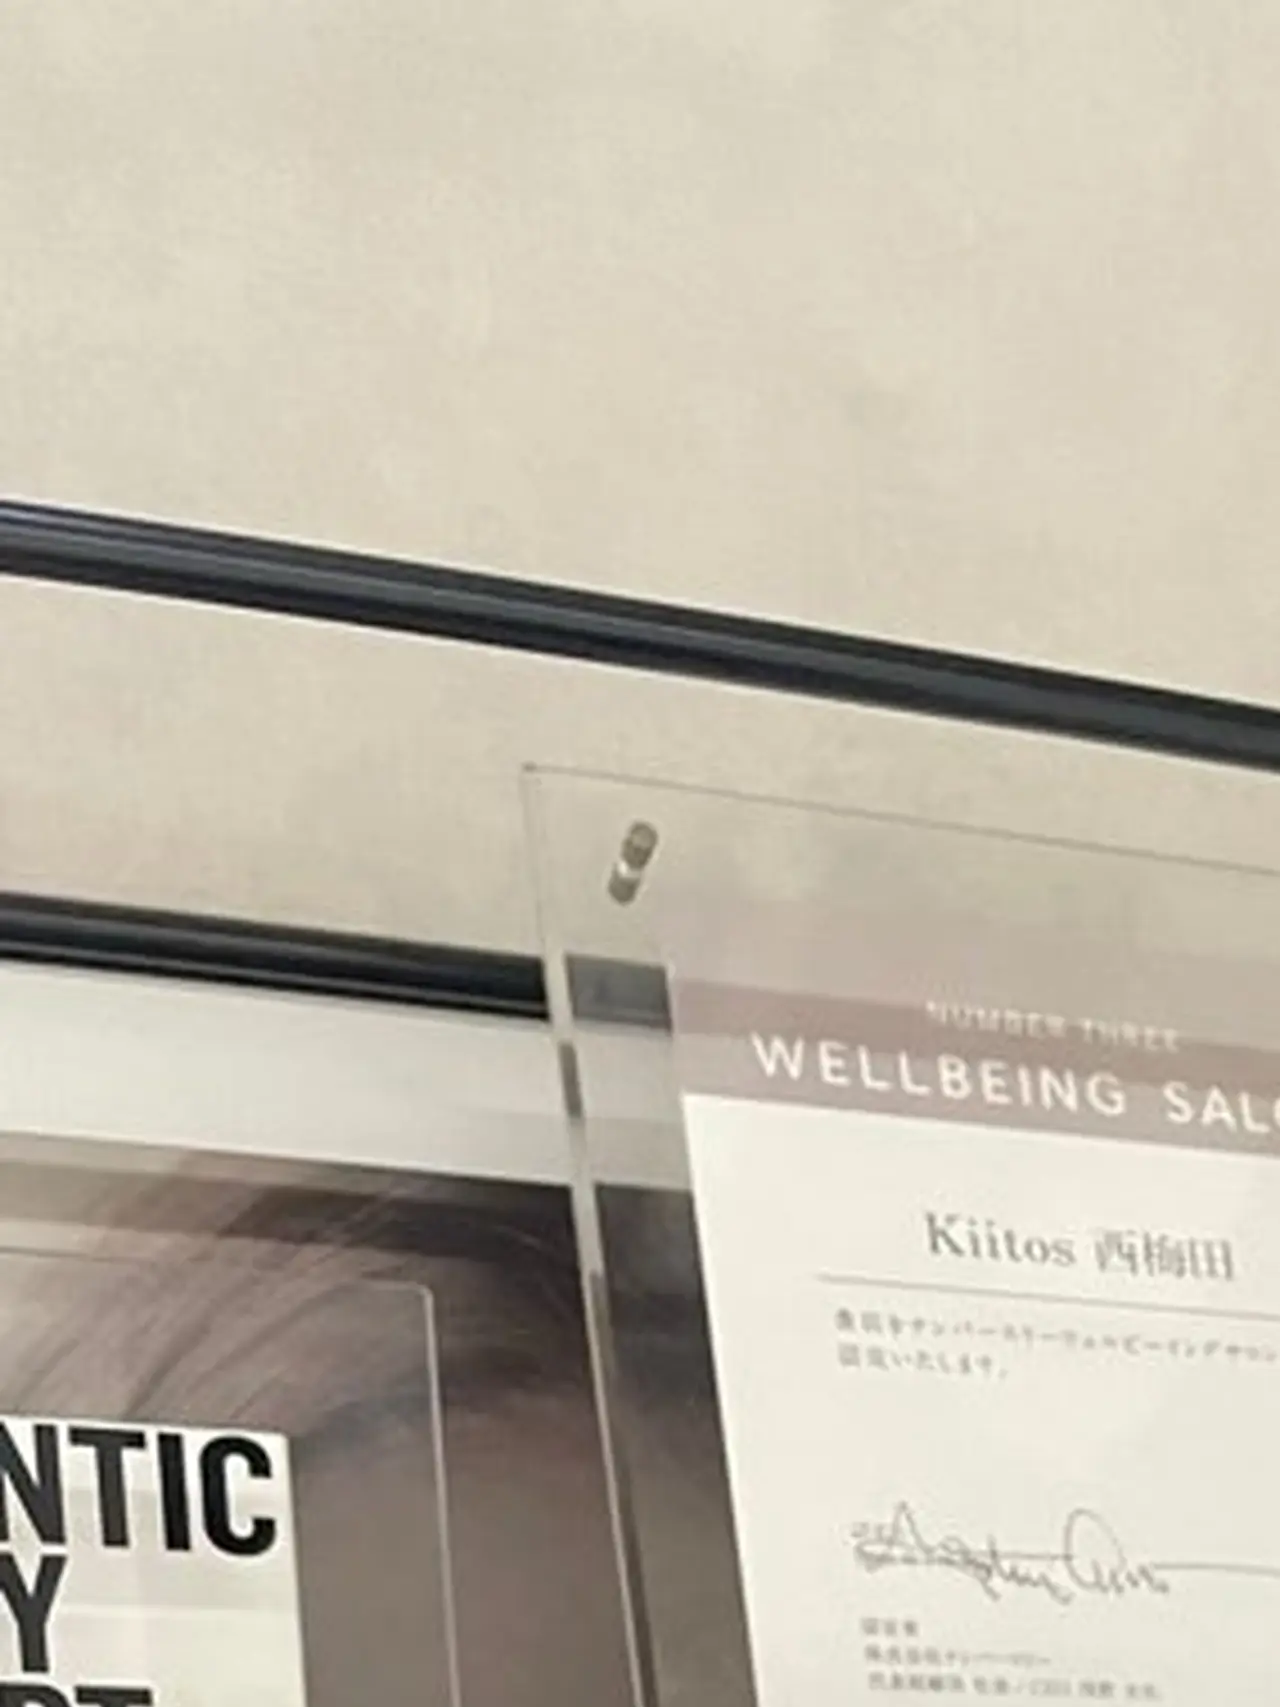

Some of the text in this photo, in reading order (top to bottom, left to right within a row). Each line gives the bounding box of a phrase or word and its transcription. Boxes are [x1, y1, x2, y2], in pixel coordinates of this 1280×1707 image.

[925, 1000, 1182, 1054] NUMBER THREE
[751, 1031, 1127, 1118] WELLBEING
[923, 1211, 1237, 1282] Kiitos 西梅田
